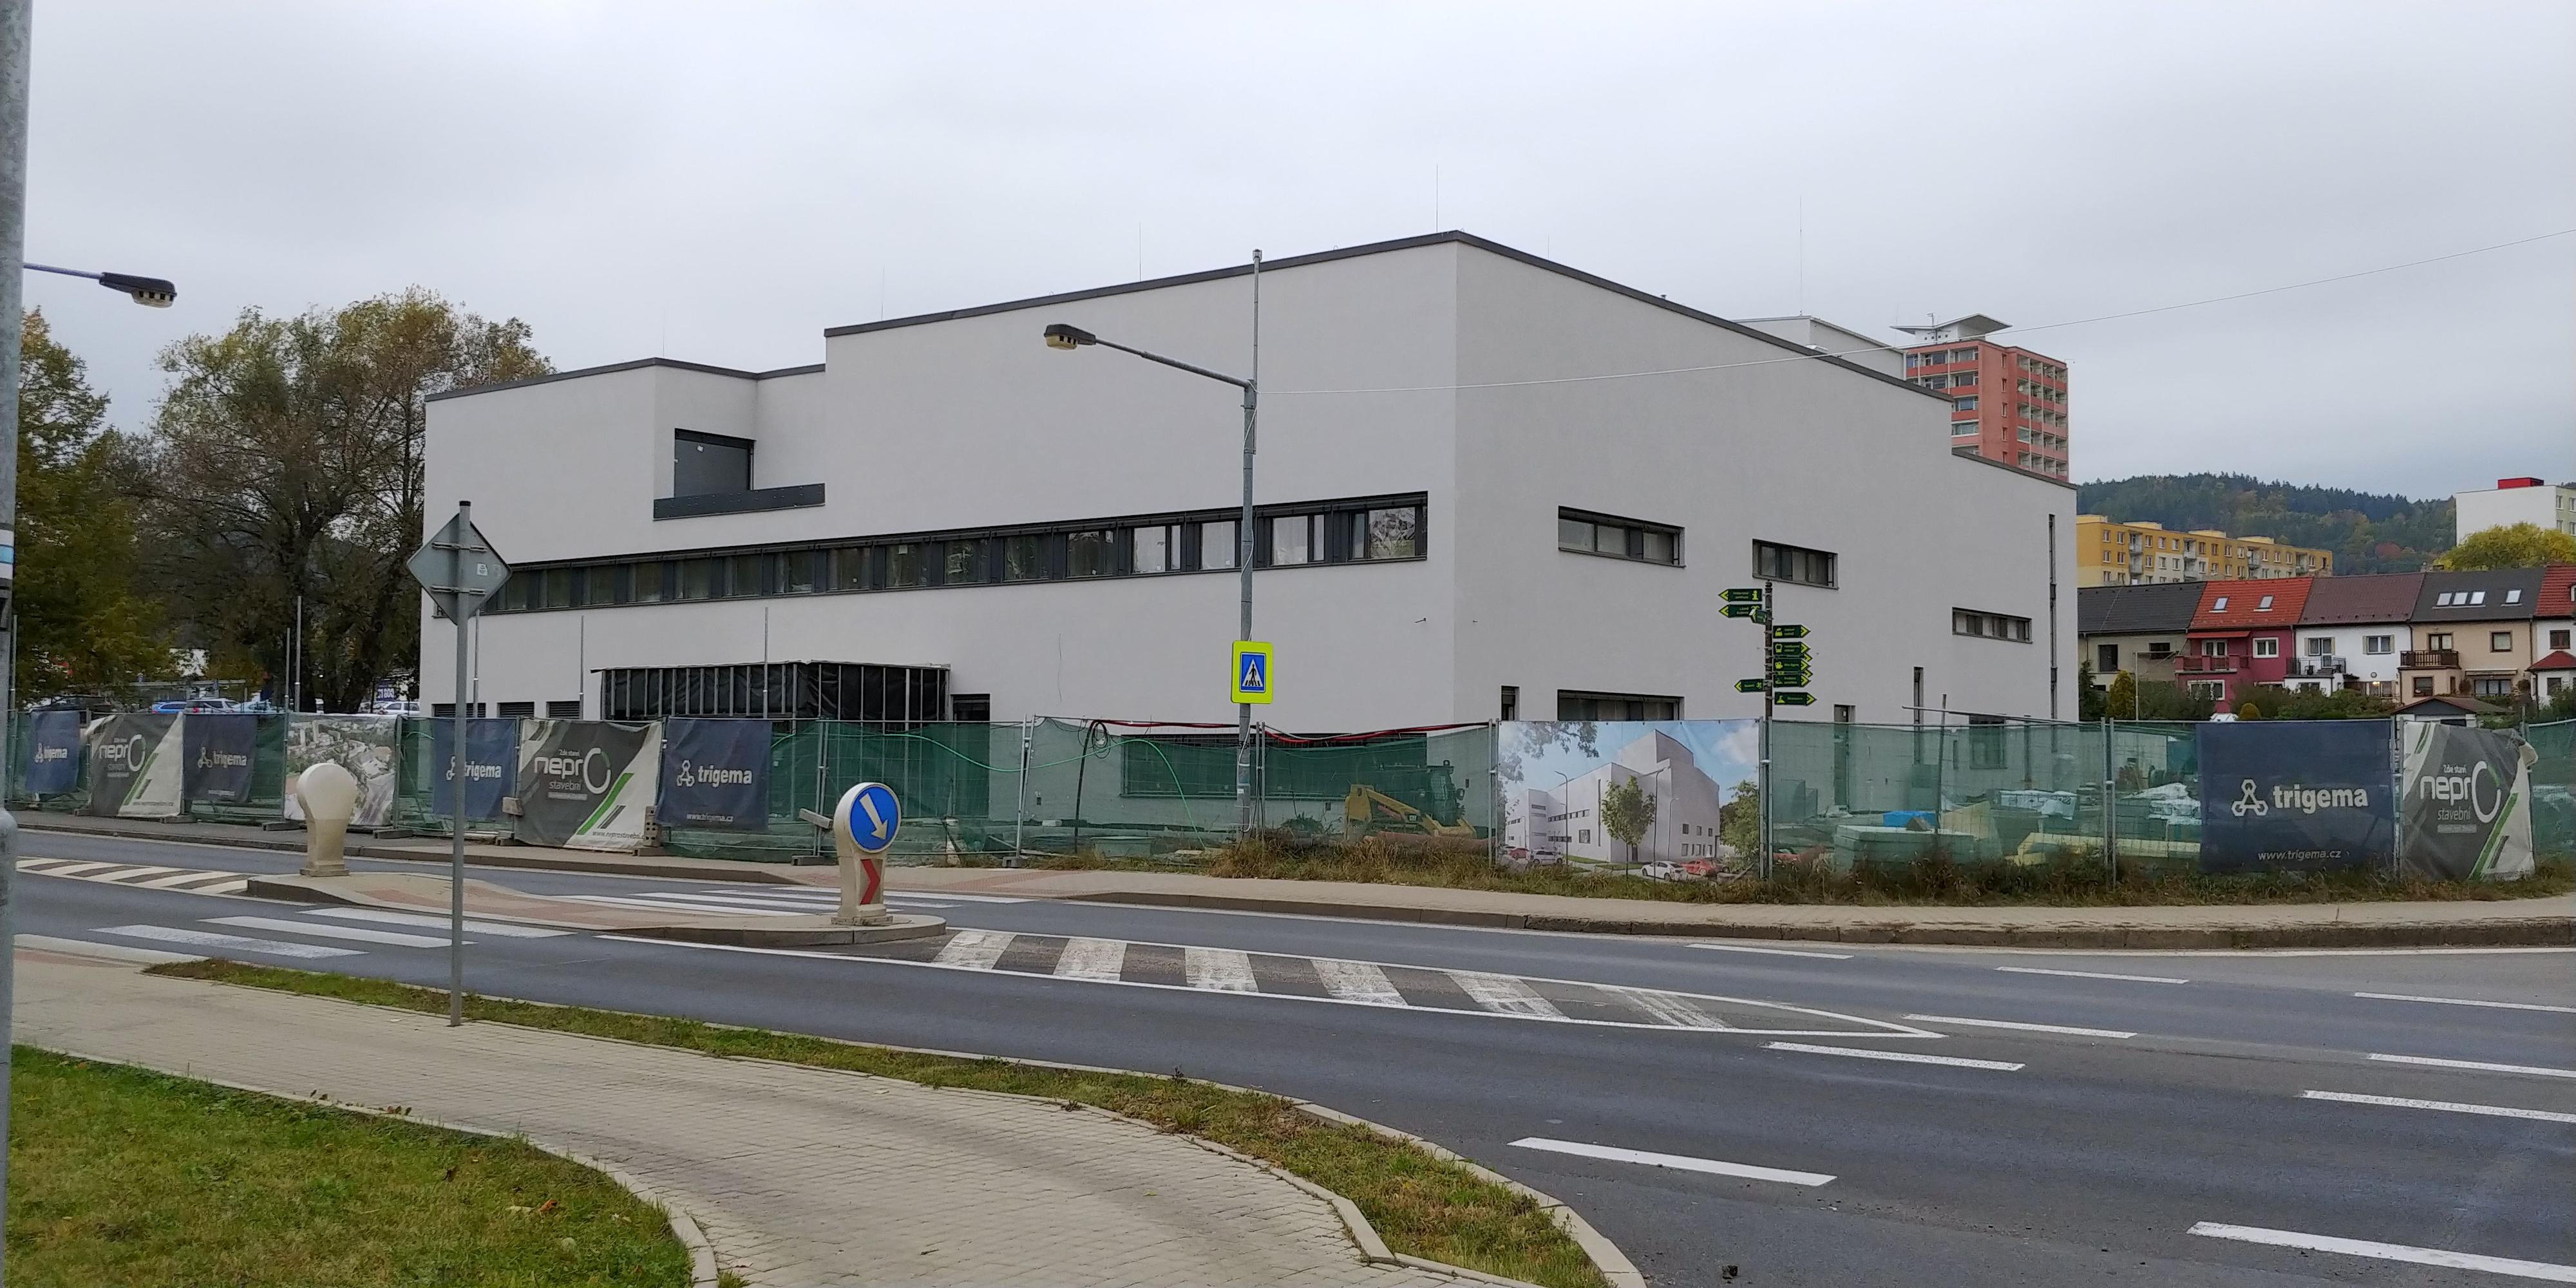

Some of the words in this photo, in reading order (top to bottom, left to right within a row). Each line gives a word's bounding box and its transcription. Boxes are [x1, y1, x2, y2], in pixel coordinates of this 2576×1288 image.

[213, 750, 247, 768] trigema
[697, 764, 753, 788] trigema
[2273, 783, 2369, 814] trigema
[2258, 849, 2342, 862] www.trigema.cz
